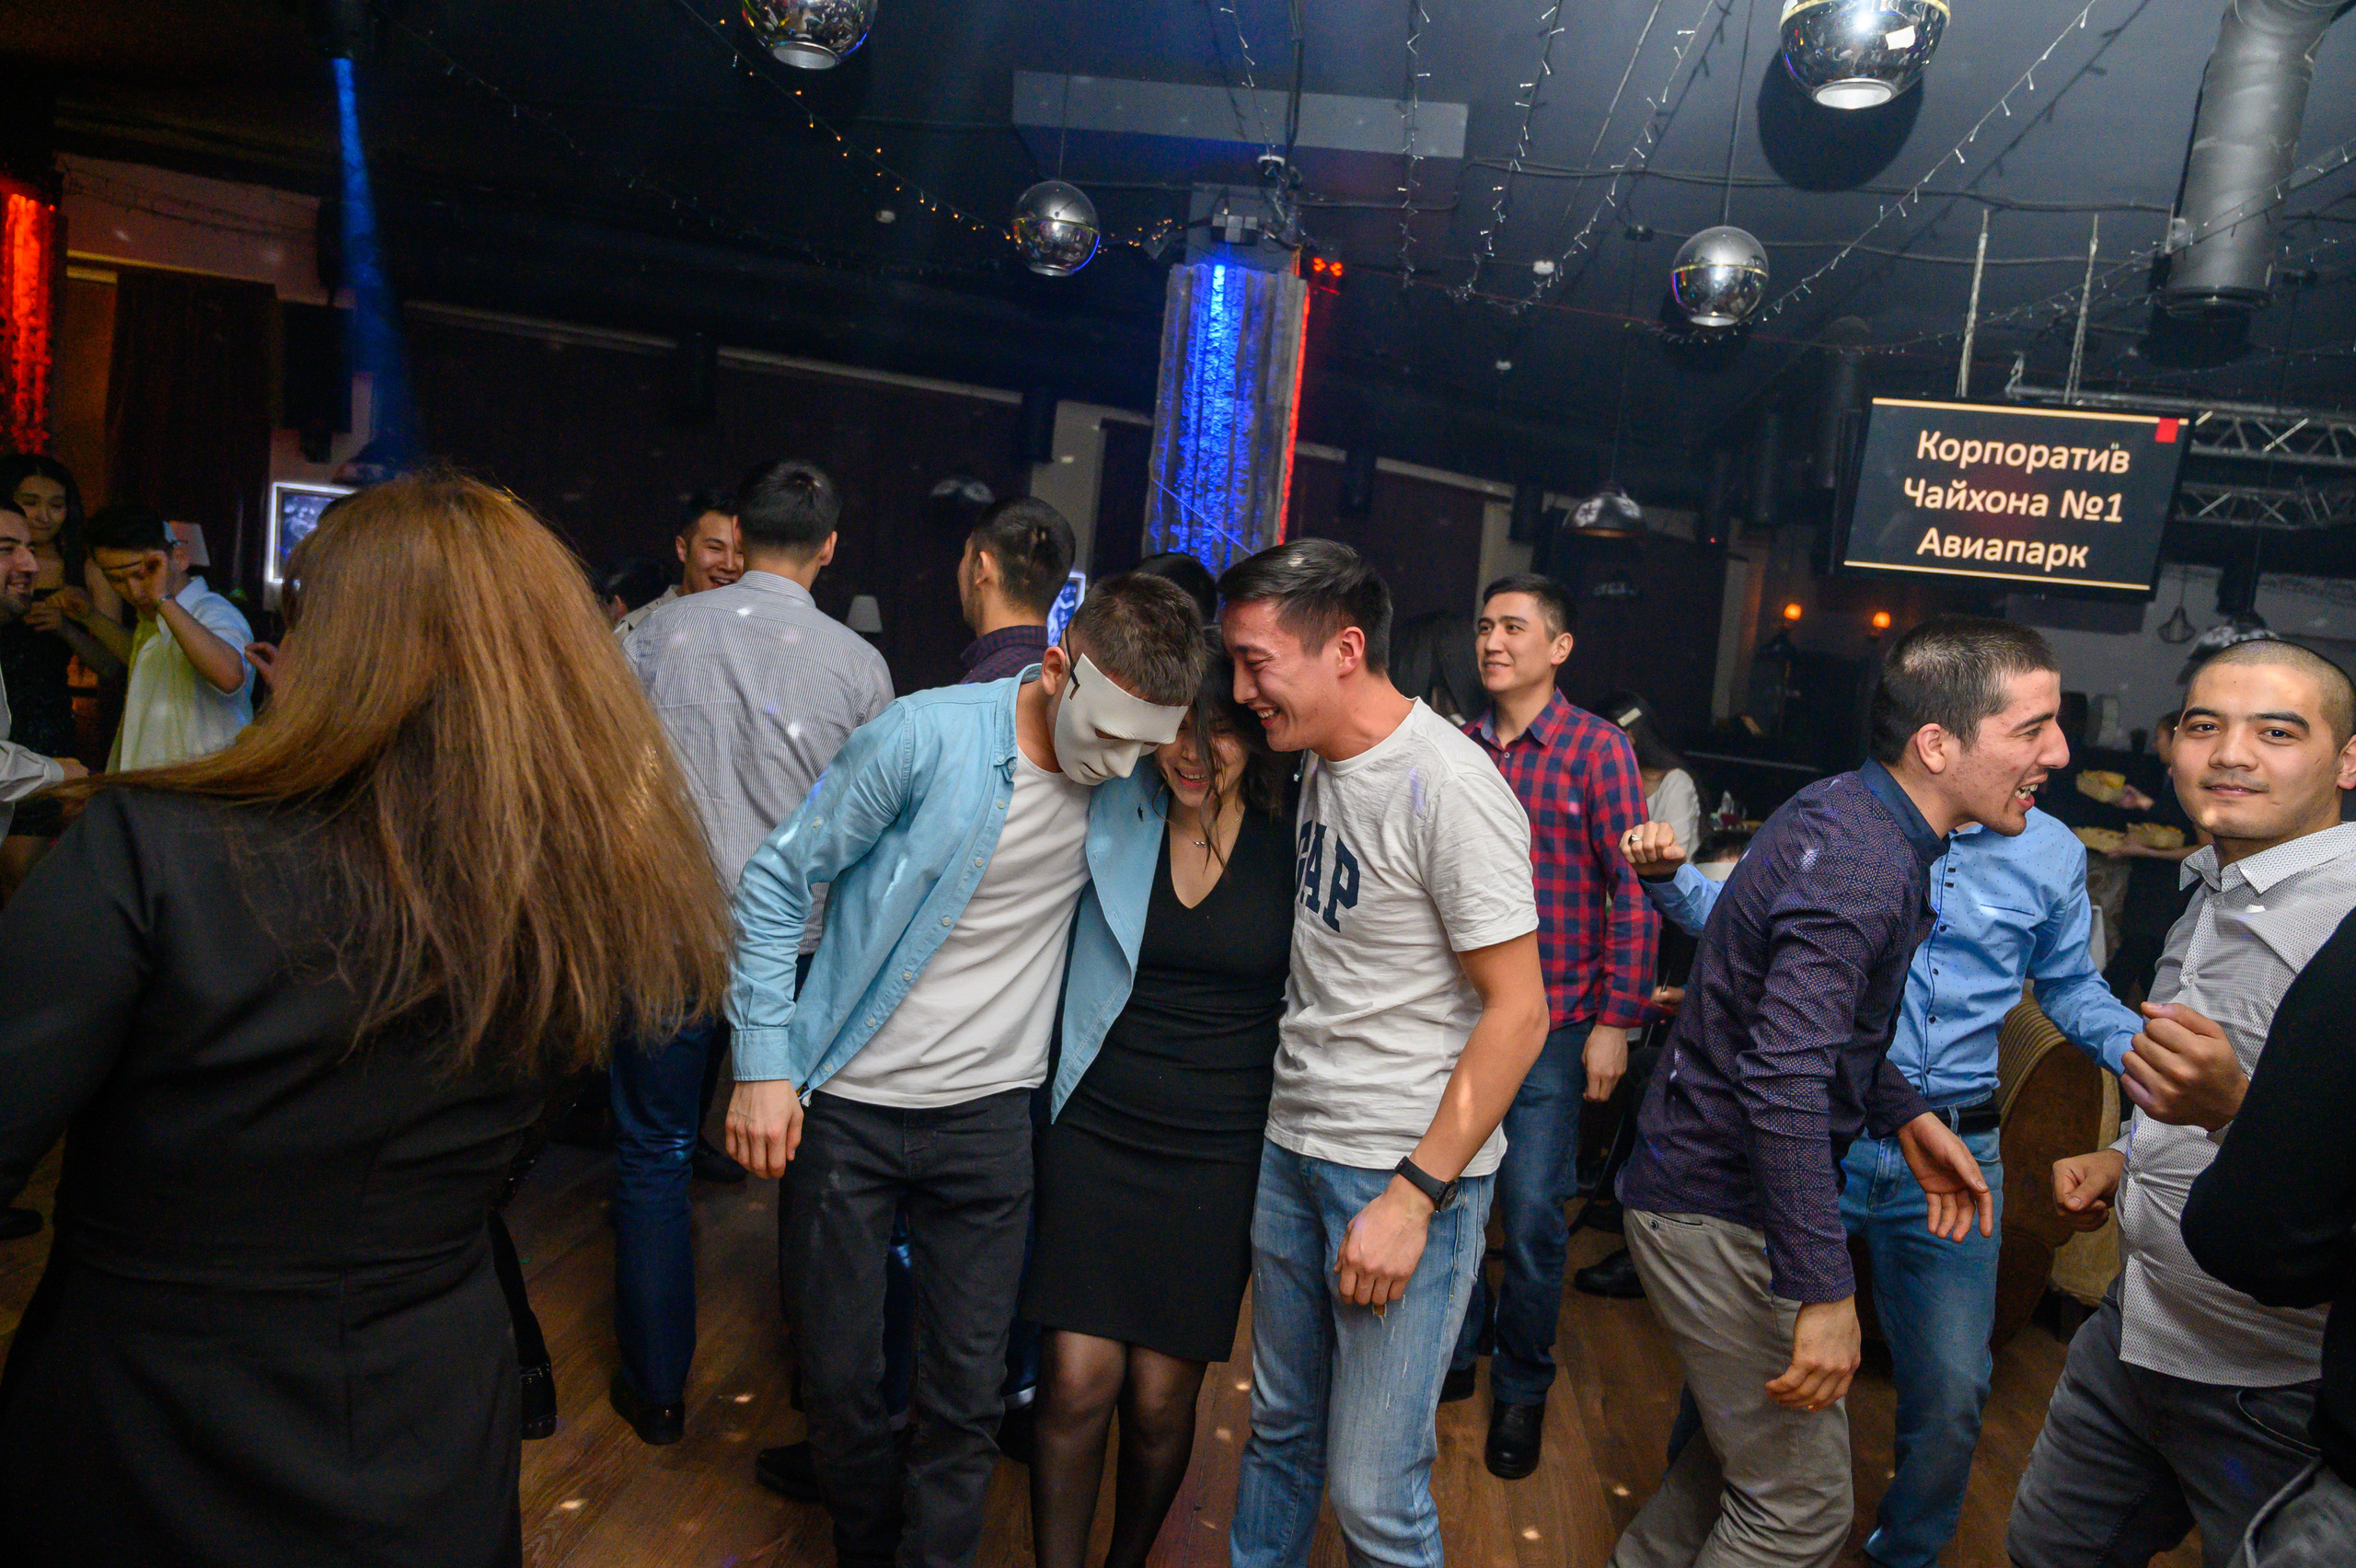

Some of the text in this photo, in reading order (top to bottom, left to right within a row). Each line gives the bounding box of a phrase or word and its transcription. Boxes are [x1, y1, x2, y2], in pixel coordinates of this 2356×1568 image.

[1917, 430, 2131, 474] Корпоратив
[1904, 477, 2123, 523] Чайхона №1
[1916, 526, 2089, 571] Авиапарк
